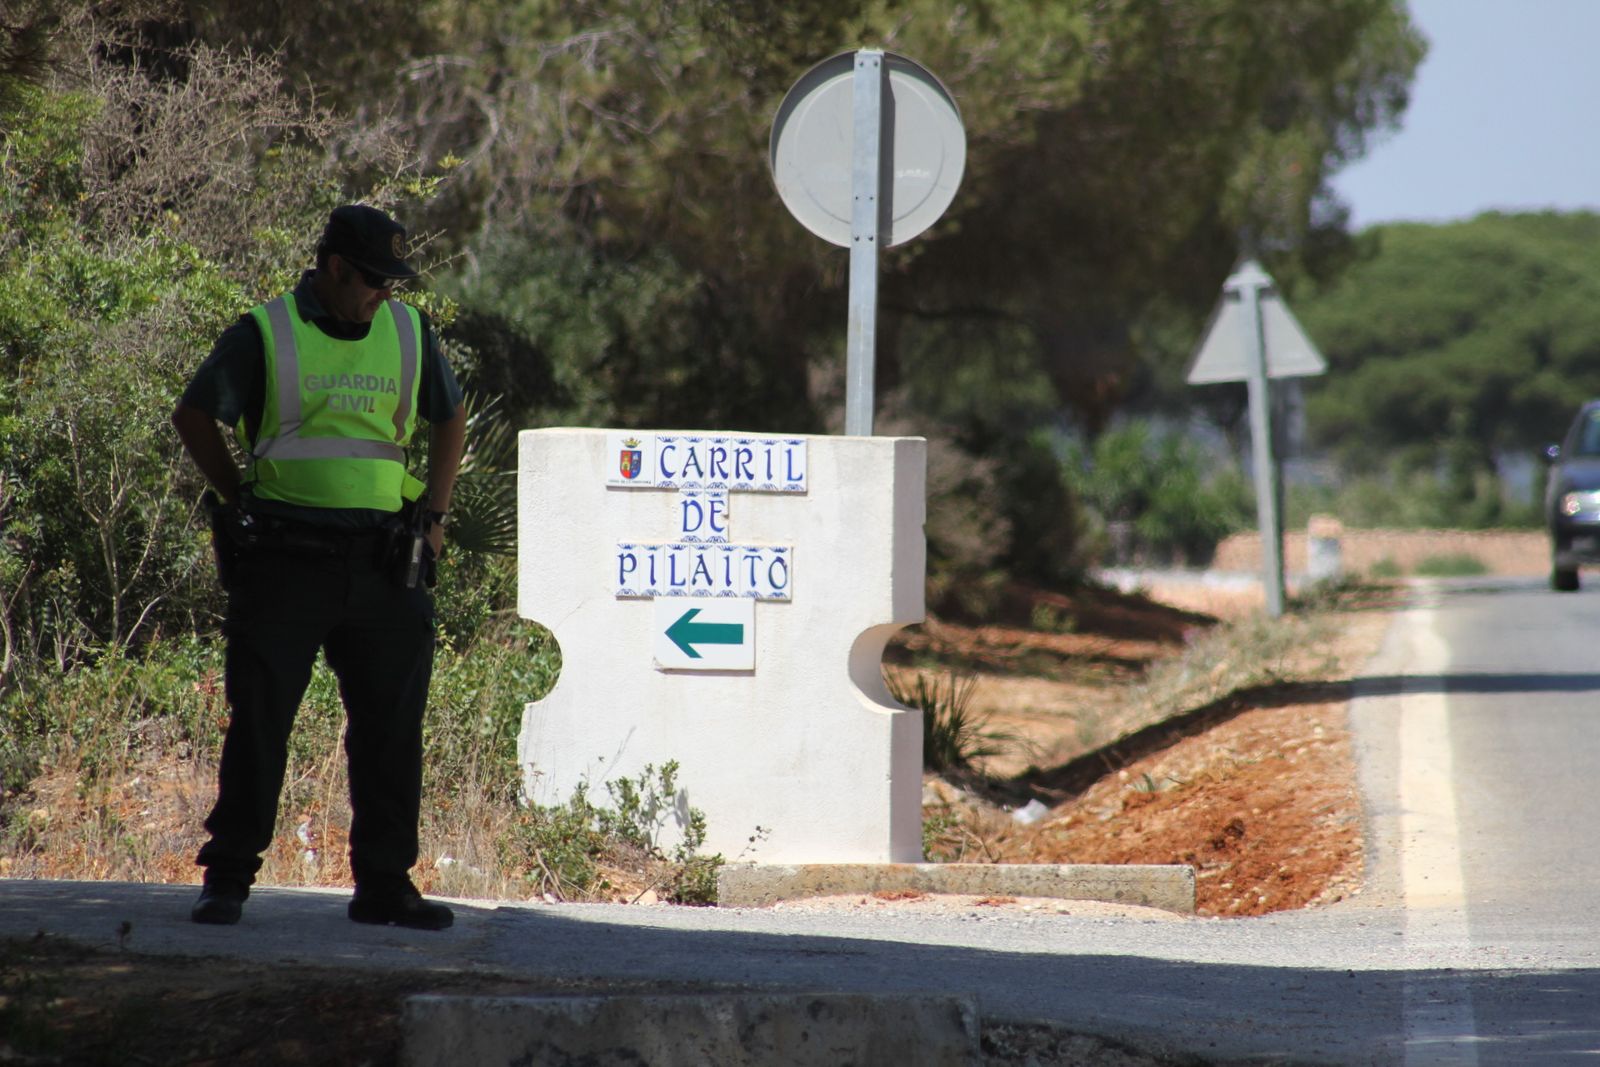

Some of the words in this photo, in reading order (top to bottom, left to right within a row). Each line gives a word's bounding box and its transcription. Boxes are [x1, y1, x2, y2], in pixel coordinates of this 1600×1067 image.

[305, 374, 397, 395] GUARDIA
[328, 394, 375, 413] CIVIL
[659, 445, 803, 482] CARRIL
[682, 499, 725, 533] DE
[618, 553, 788, 590] PILAITO
